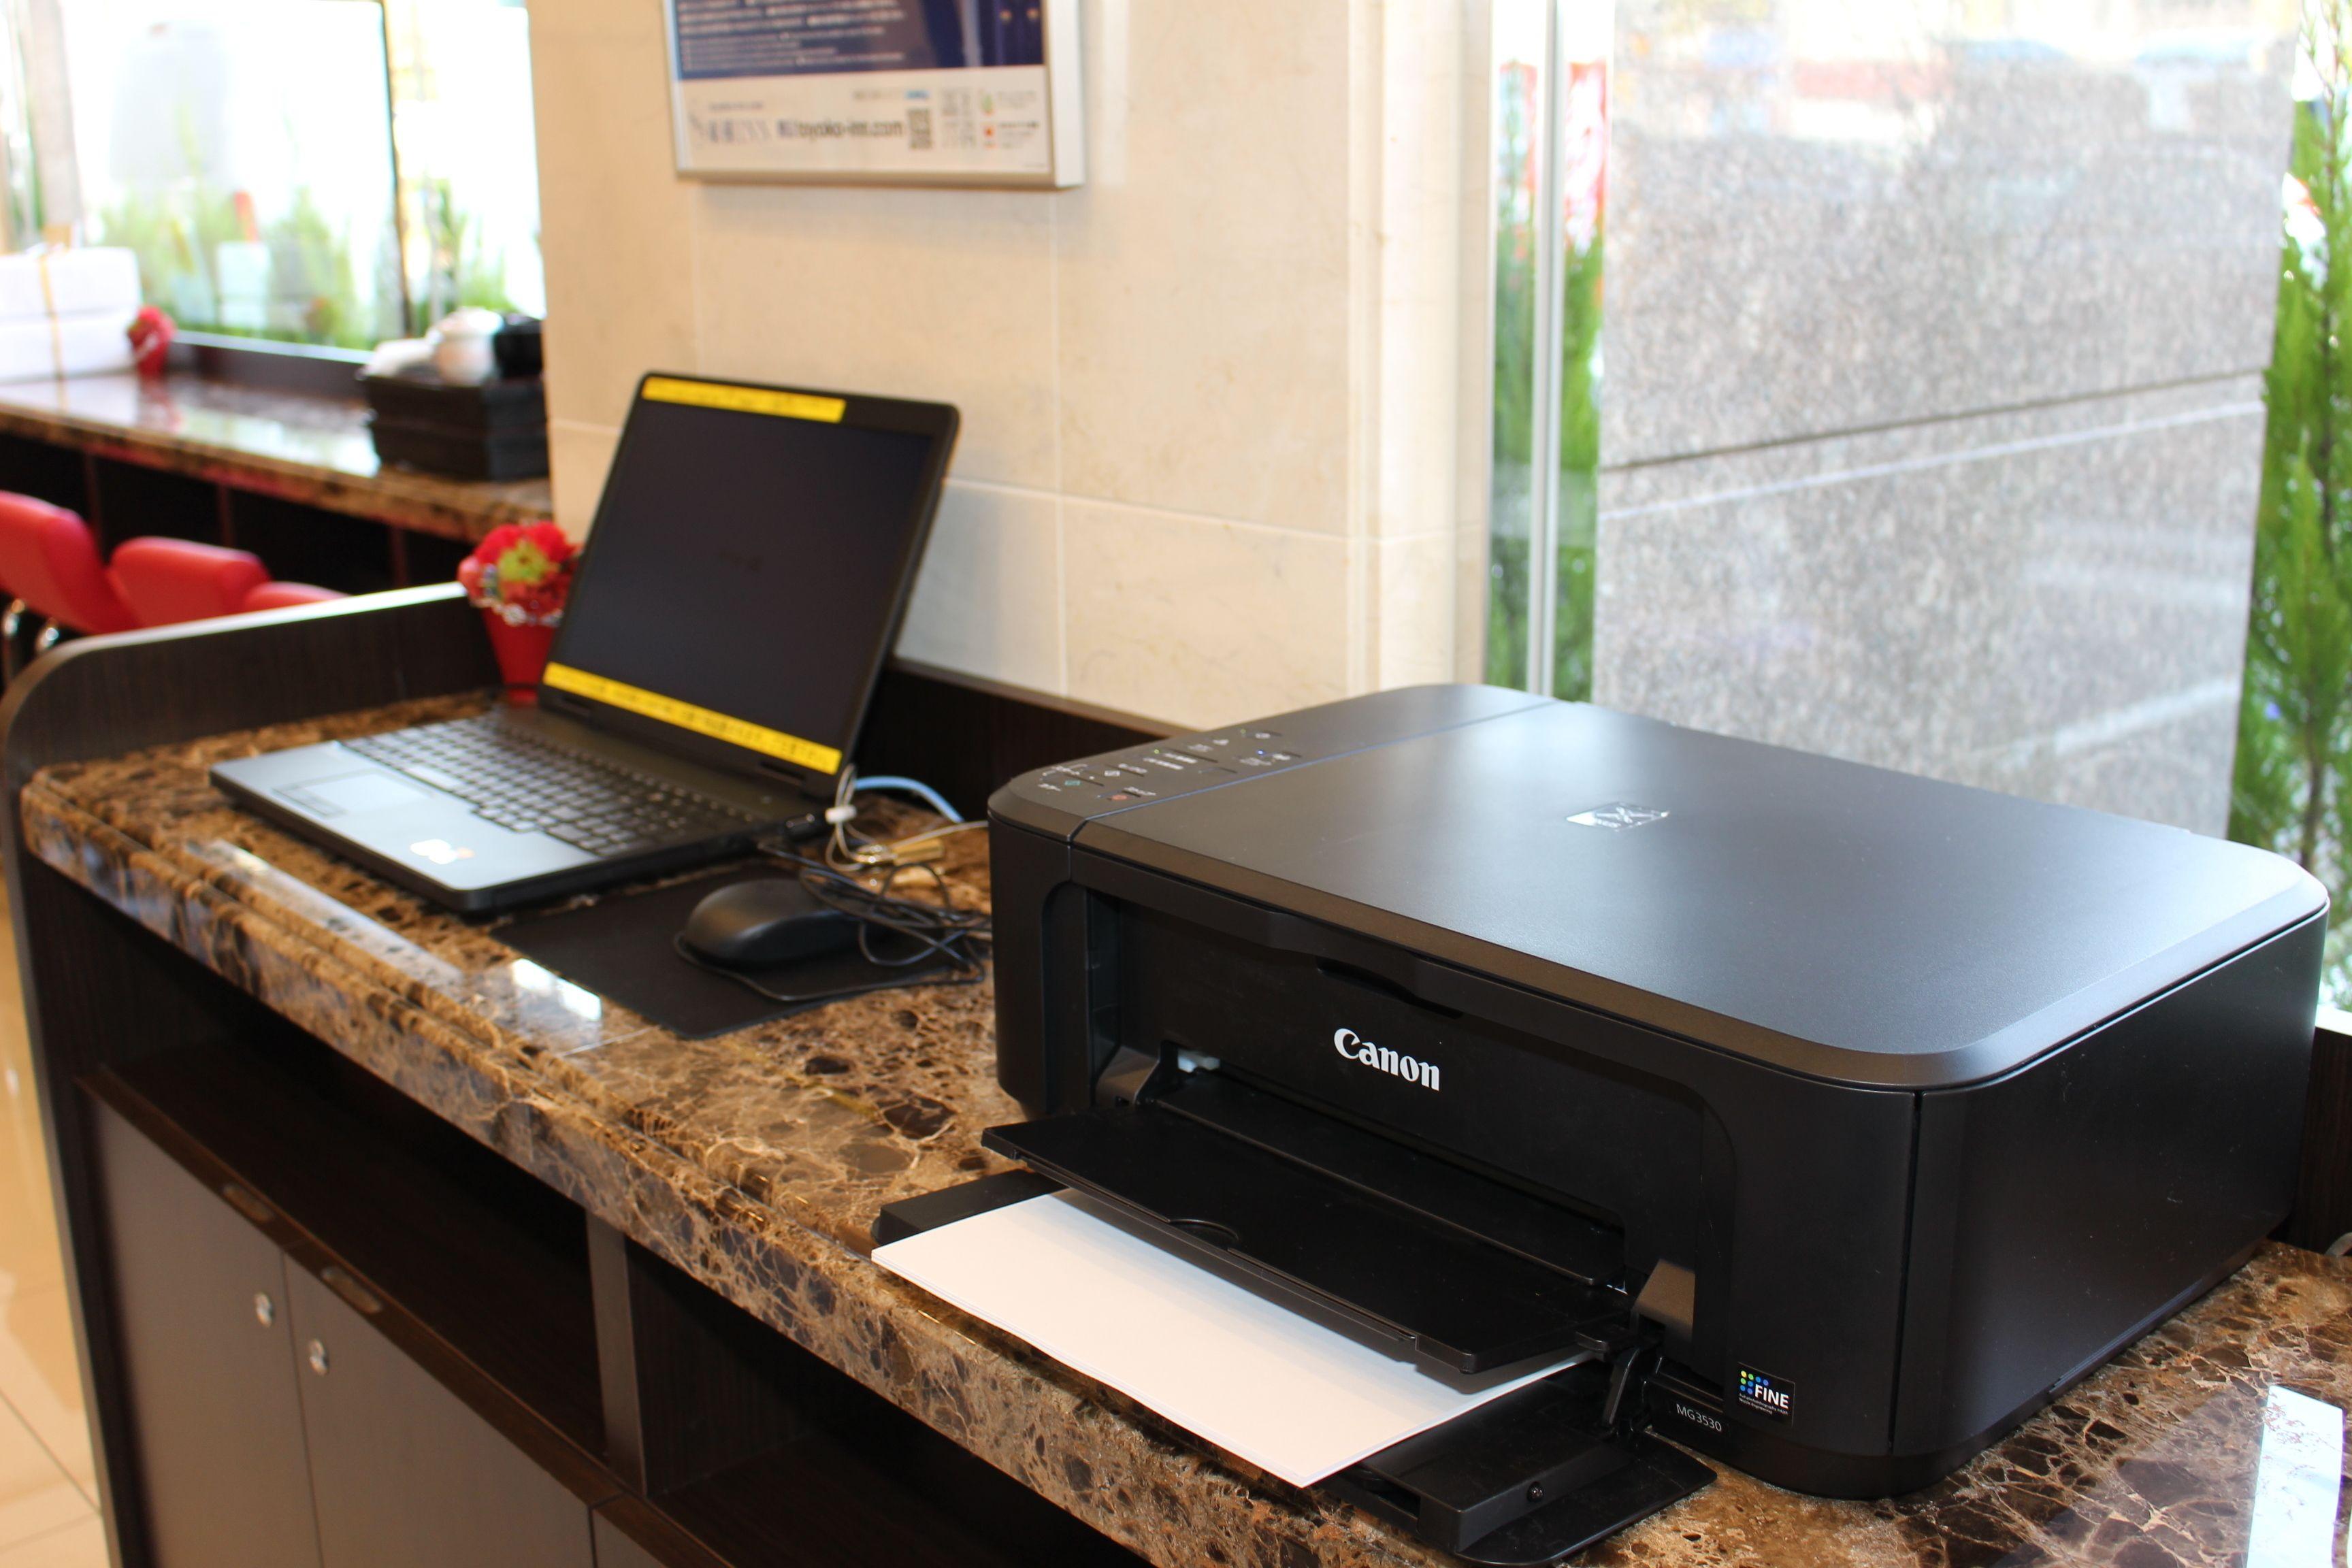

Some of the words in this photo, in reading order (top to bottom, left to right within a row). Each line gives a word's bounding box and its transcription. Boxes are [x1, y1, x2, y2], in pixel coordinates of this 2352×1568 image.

[1333, 1028, 1440, 1091] Canon
[1754, 1384, 1789, 1409] FINE
[1676, 1403, 1722, 1433] MG3530
